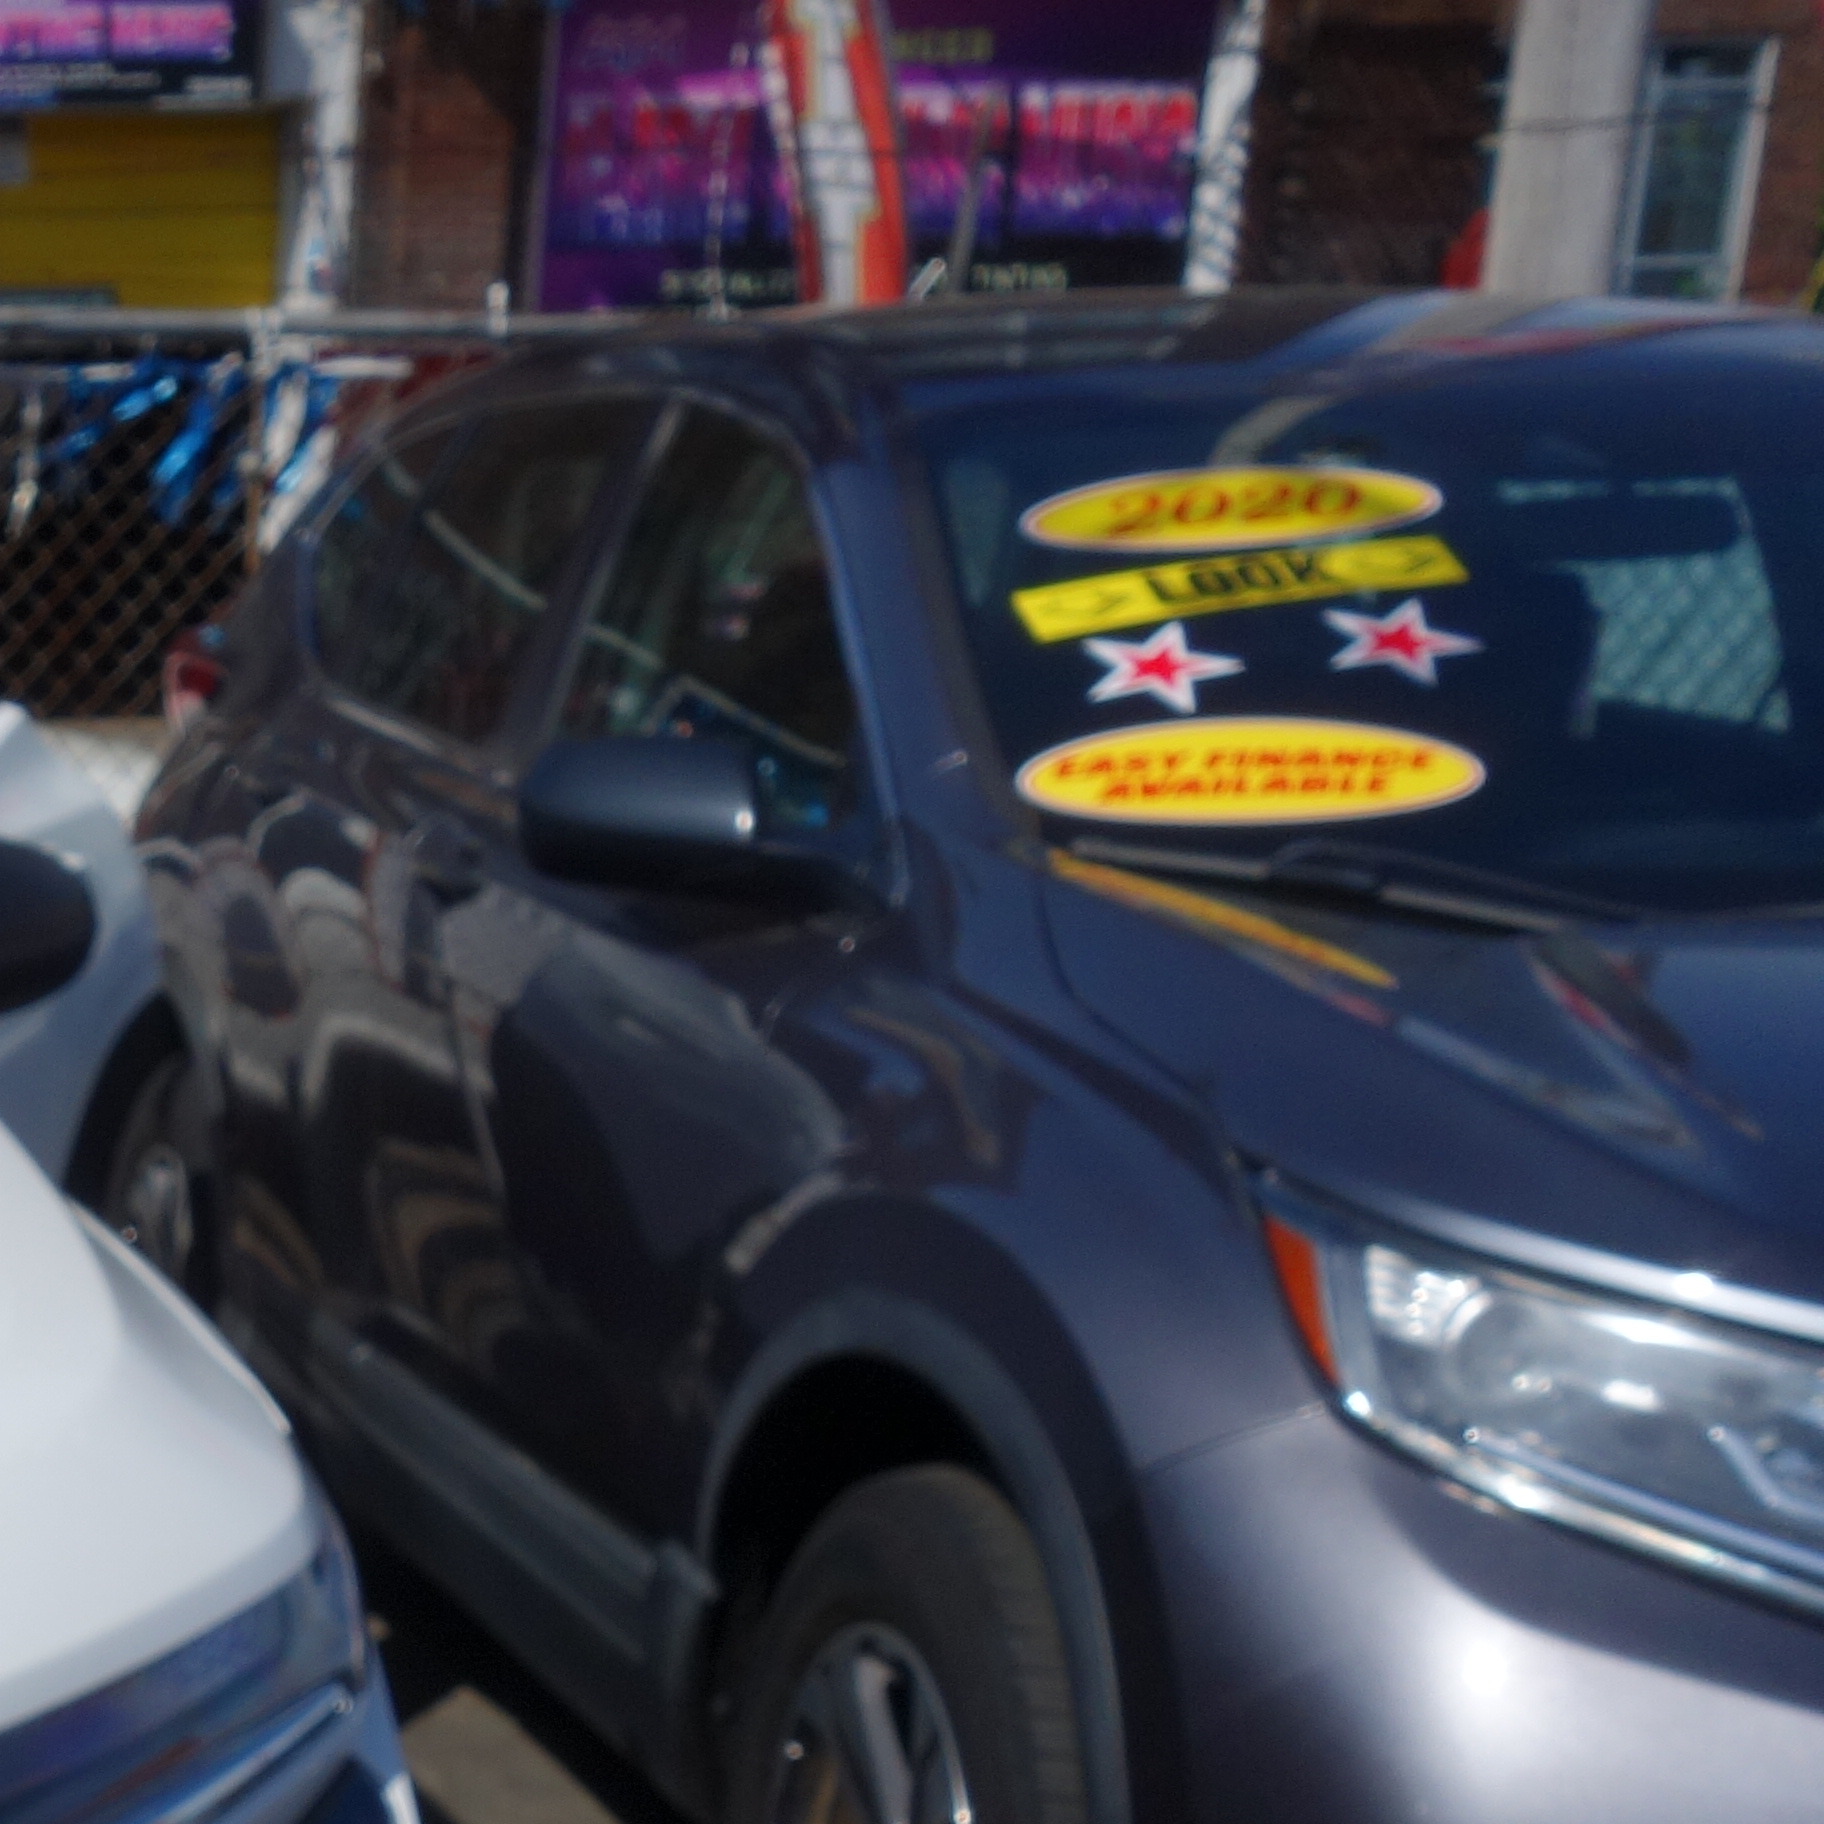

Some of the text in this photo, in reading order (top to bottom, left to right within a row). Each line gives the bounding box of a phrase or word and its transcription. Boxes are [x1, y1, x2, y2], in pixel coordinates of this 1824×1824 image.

[1107, 479, 1361, 538] 2020
[1147, 550, 1339, 603] LOOK
[1054, 747, 1434, 779] EASY FINANCE
[1097, 773, 1390, 800] AVAILABLE
